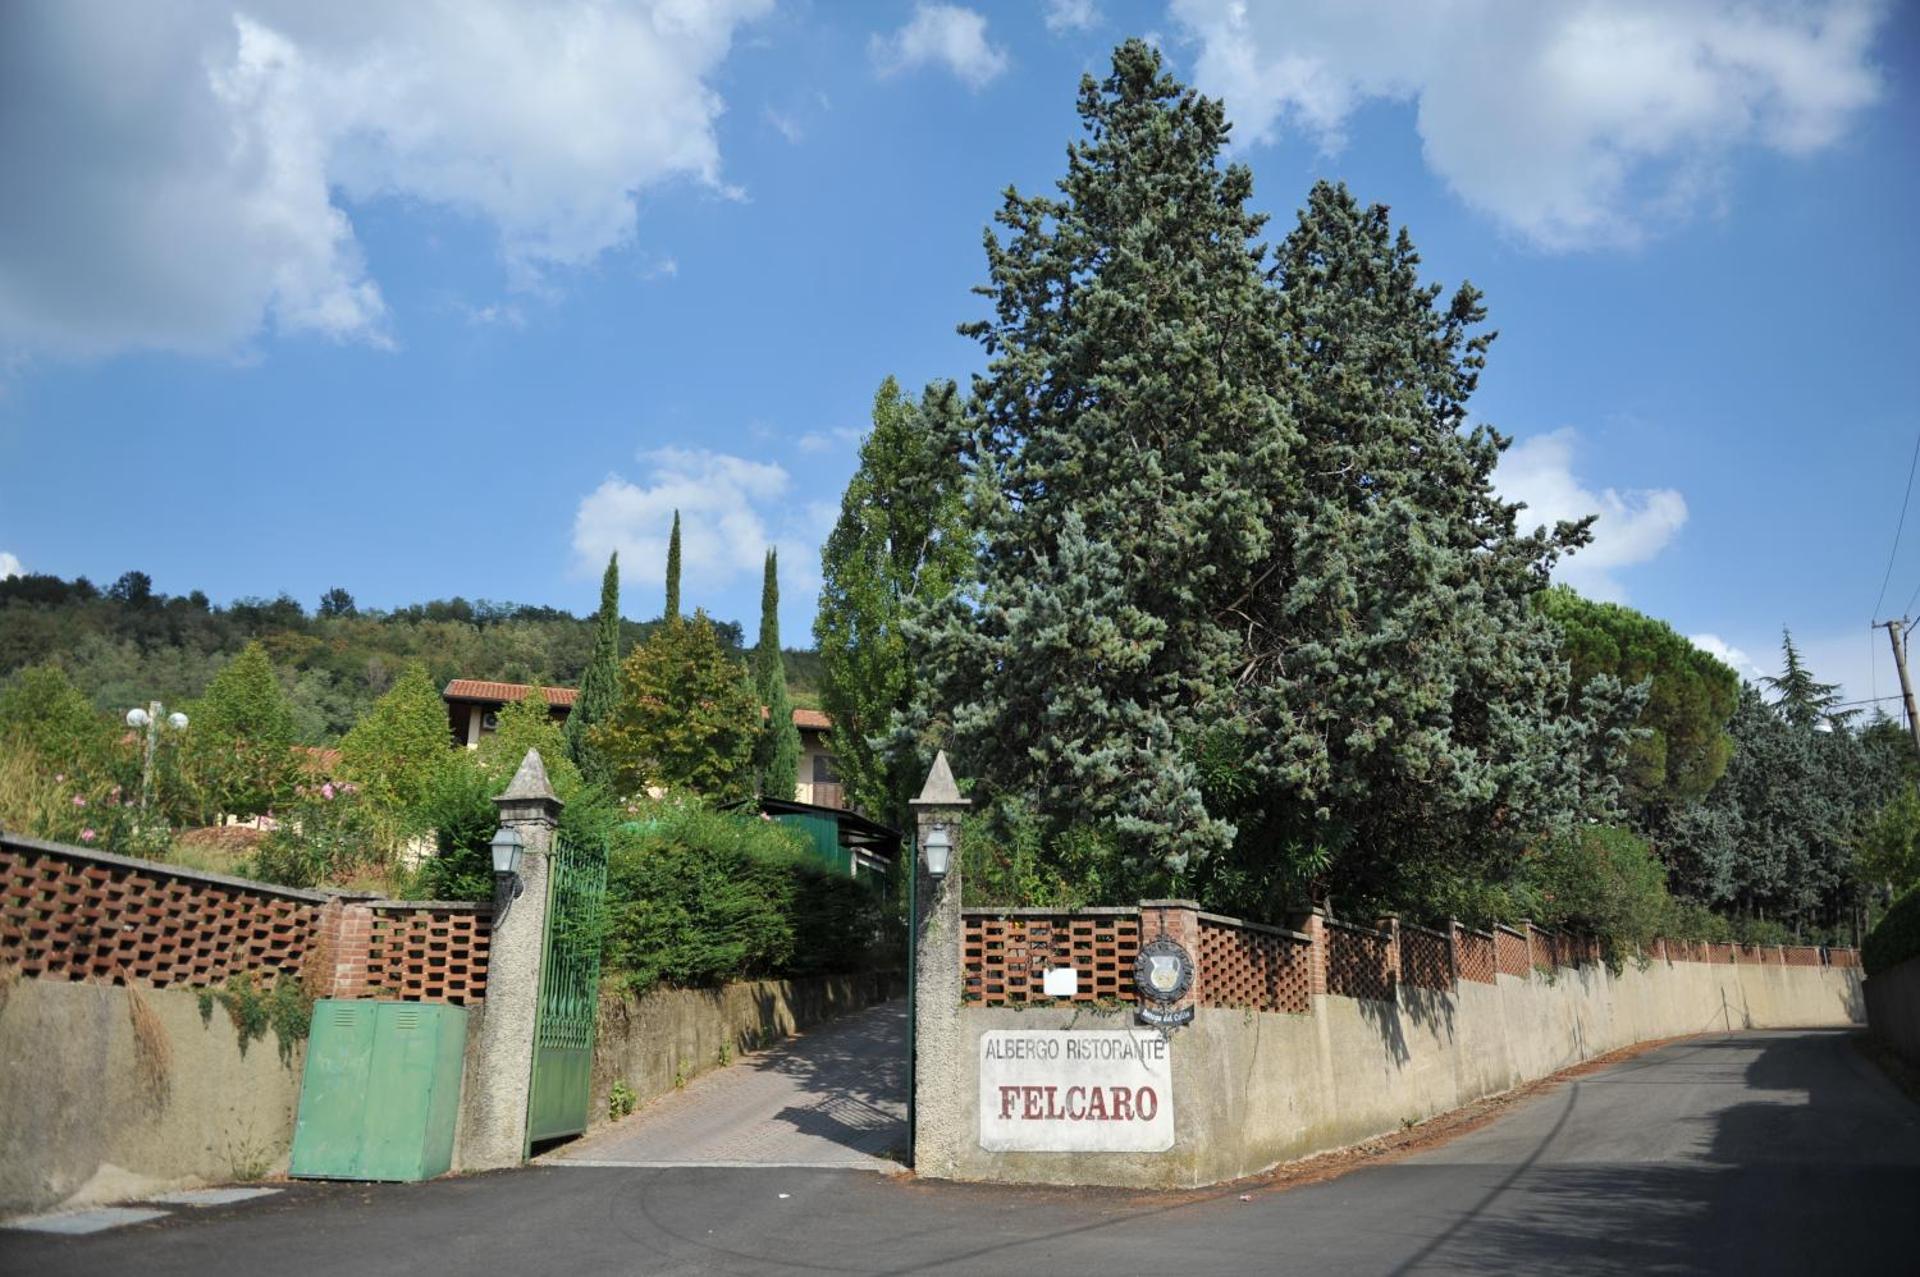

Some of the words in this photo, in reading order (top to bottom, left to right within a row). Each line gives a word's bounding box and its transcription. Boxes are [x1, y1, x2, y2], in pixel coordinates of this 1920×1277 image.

[986, 1039, 1059, 1060] ALBERGO
[1067, 1039, 1164, 1060] RISTORANTE
[998, 1085, 1158, 1121] FELCARO
